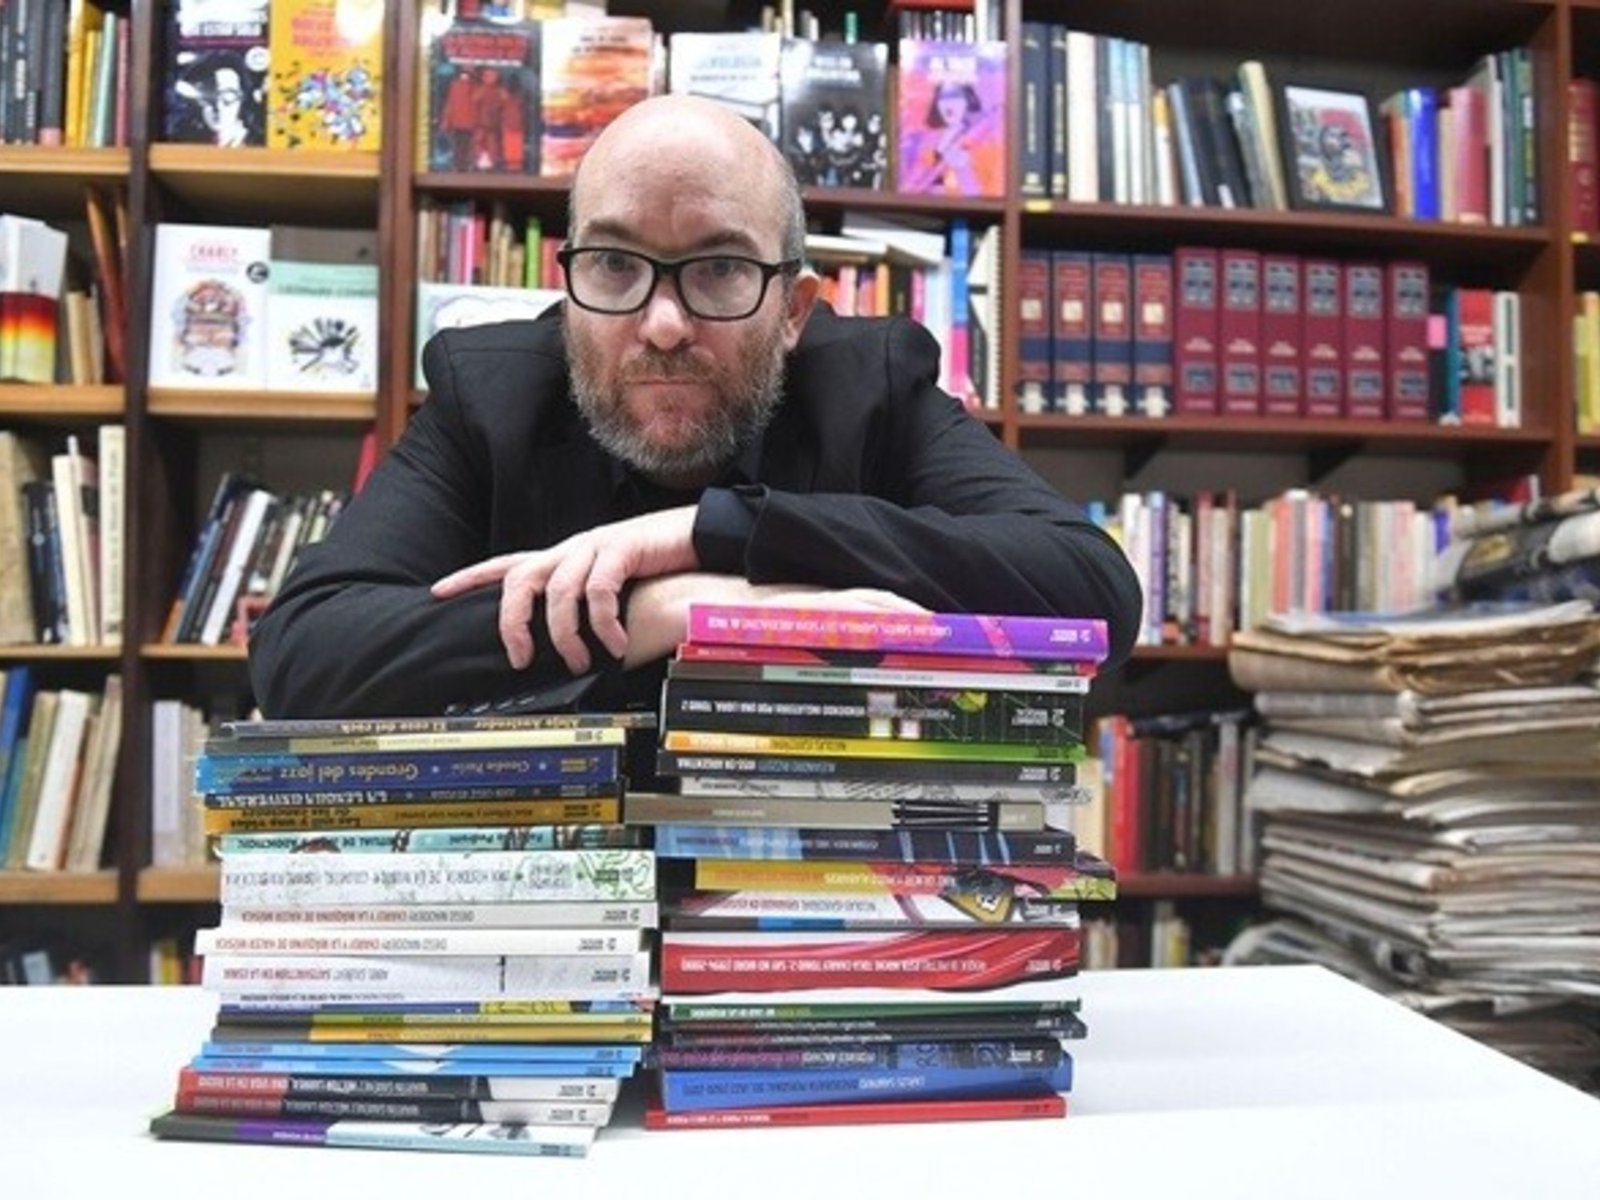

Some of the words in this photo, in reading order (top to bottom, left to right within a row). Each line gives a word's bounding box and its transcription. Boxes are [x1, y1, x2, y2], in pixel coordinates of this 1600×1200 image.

[279, 763, 314, 781] jazz
[319, 766, 345, 782] del
[348, 763, 418, 780] Grandes
[216, 793, 303, 806] UNIVERSAL
[305, 792, 364, 804] LENGUA
[368, 791, 387, 803] LA
